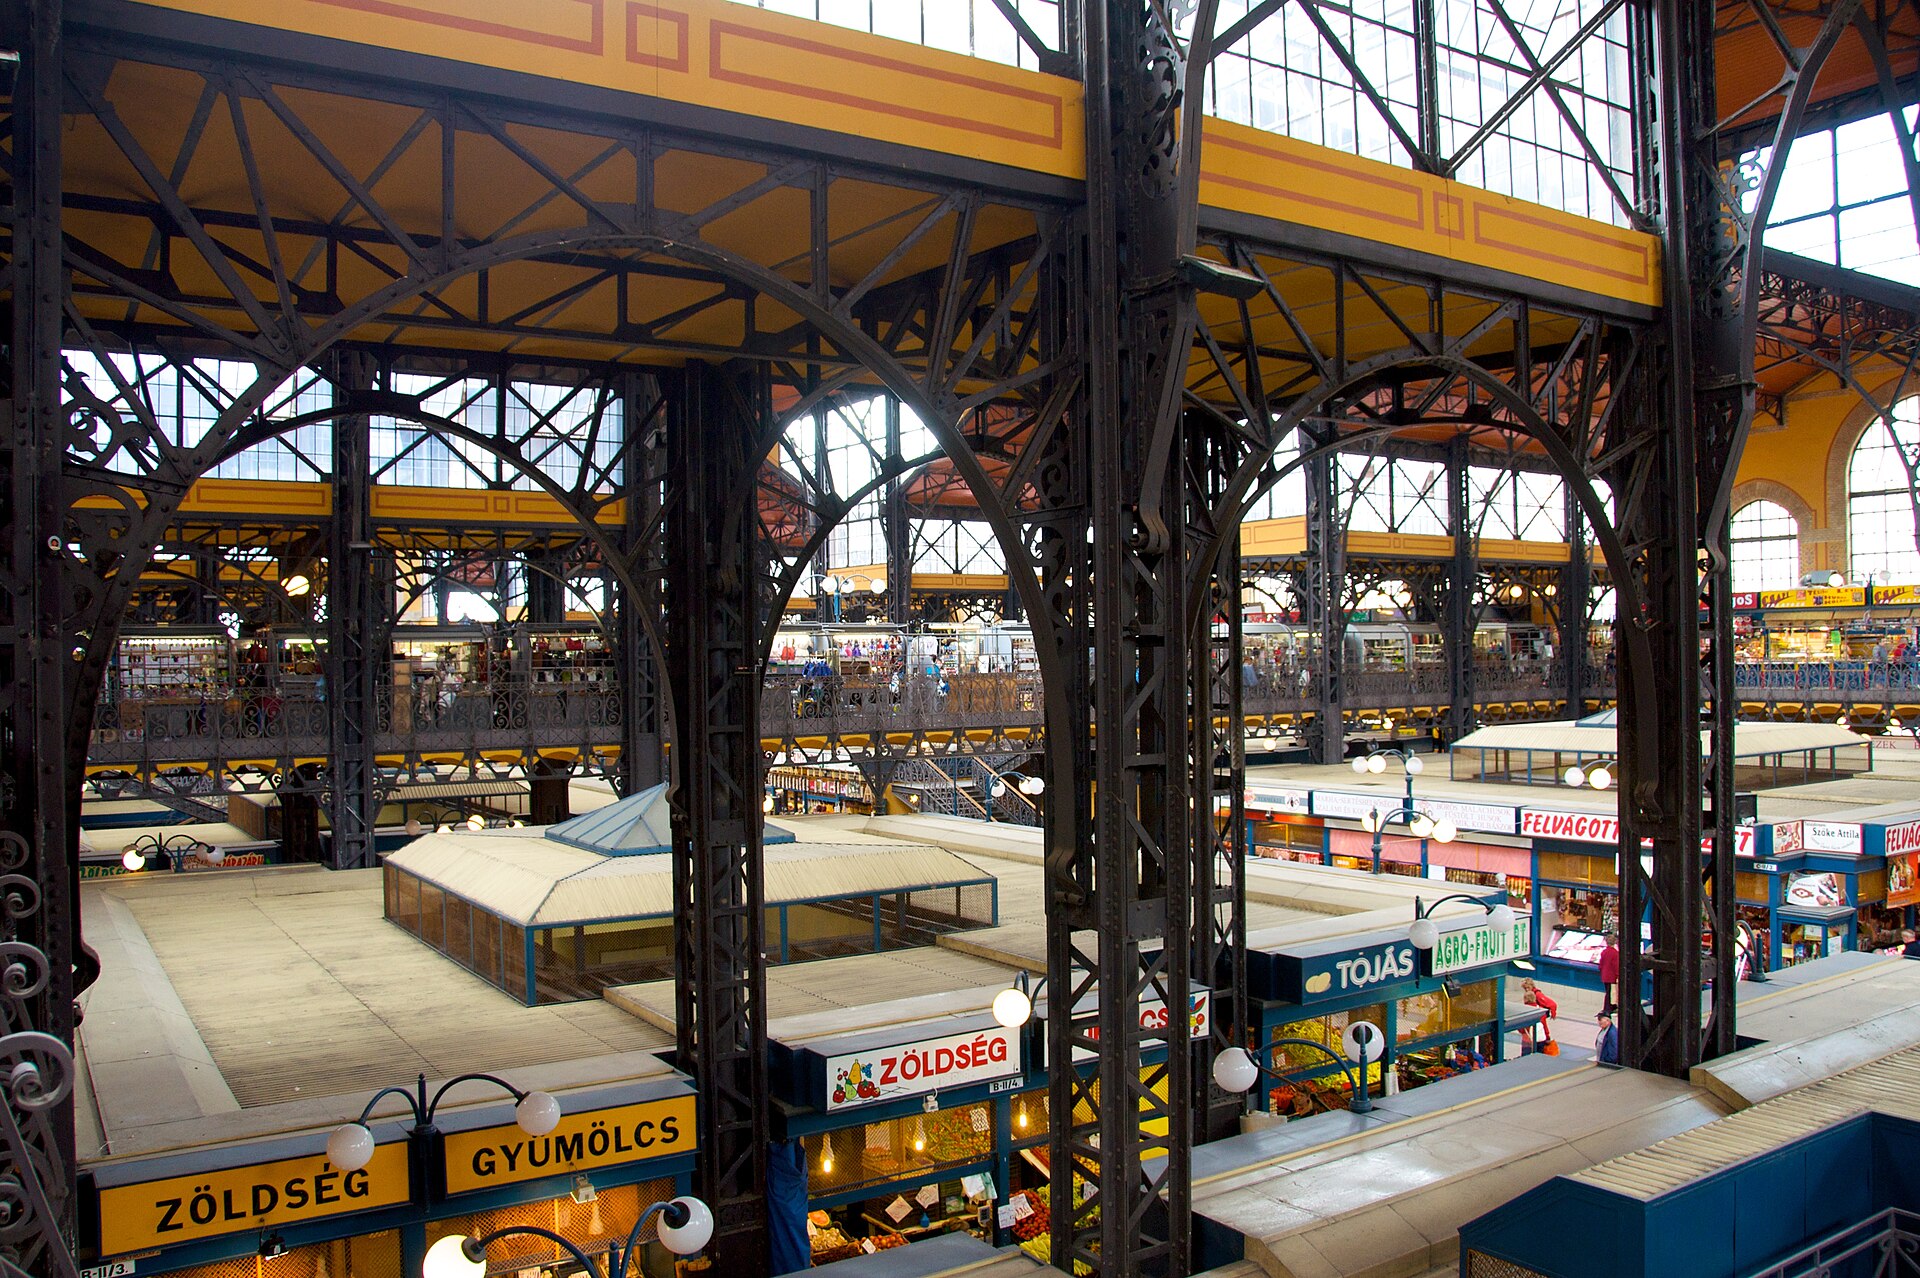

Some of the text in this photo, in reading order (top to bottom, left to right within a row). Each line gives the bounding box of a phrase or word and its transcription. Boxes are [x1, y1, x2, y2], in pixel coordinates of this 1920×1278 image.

[1523, 813, 1618, 840] FELVÁGOTT
[1837, 829, 1860, 839] Attila
[1336, 946, 1414, 989] TOJÁS
[1435, 923, 1528, 969] AGRO-FRUIT BT.
[879, 1034, 1008, 1086] ZÖLDSÉG
[472, 1116, 680, 1177] GYÜMÖLCS
[155, 1163, 370, 1233] ZÖLDSÉG
